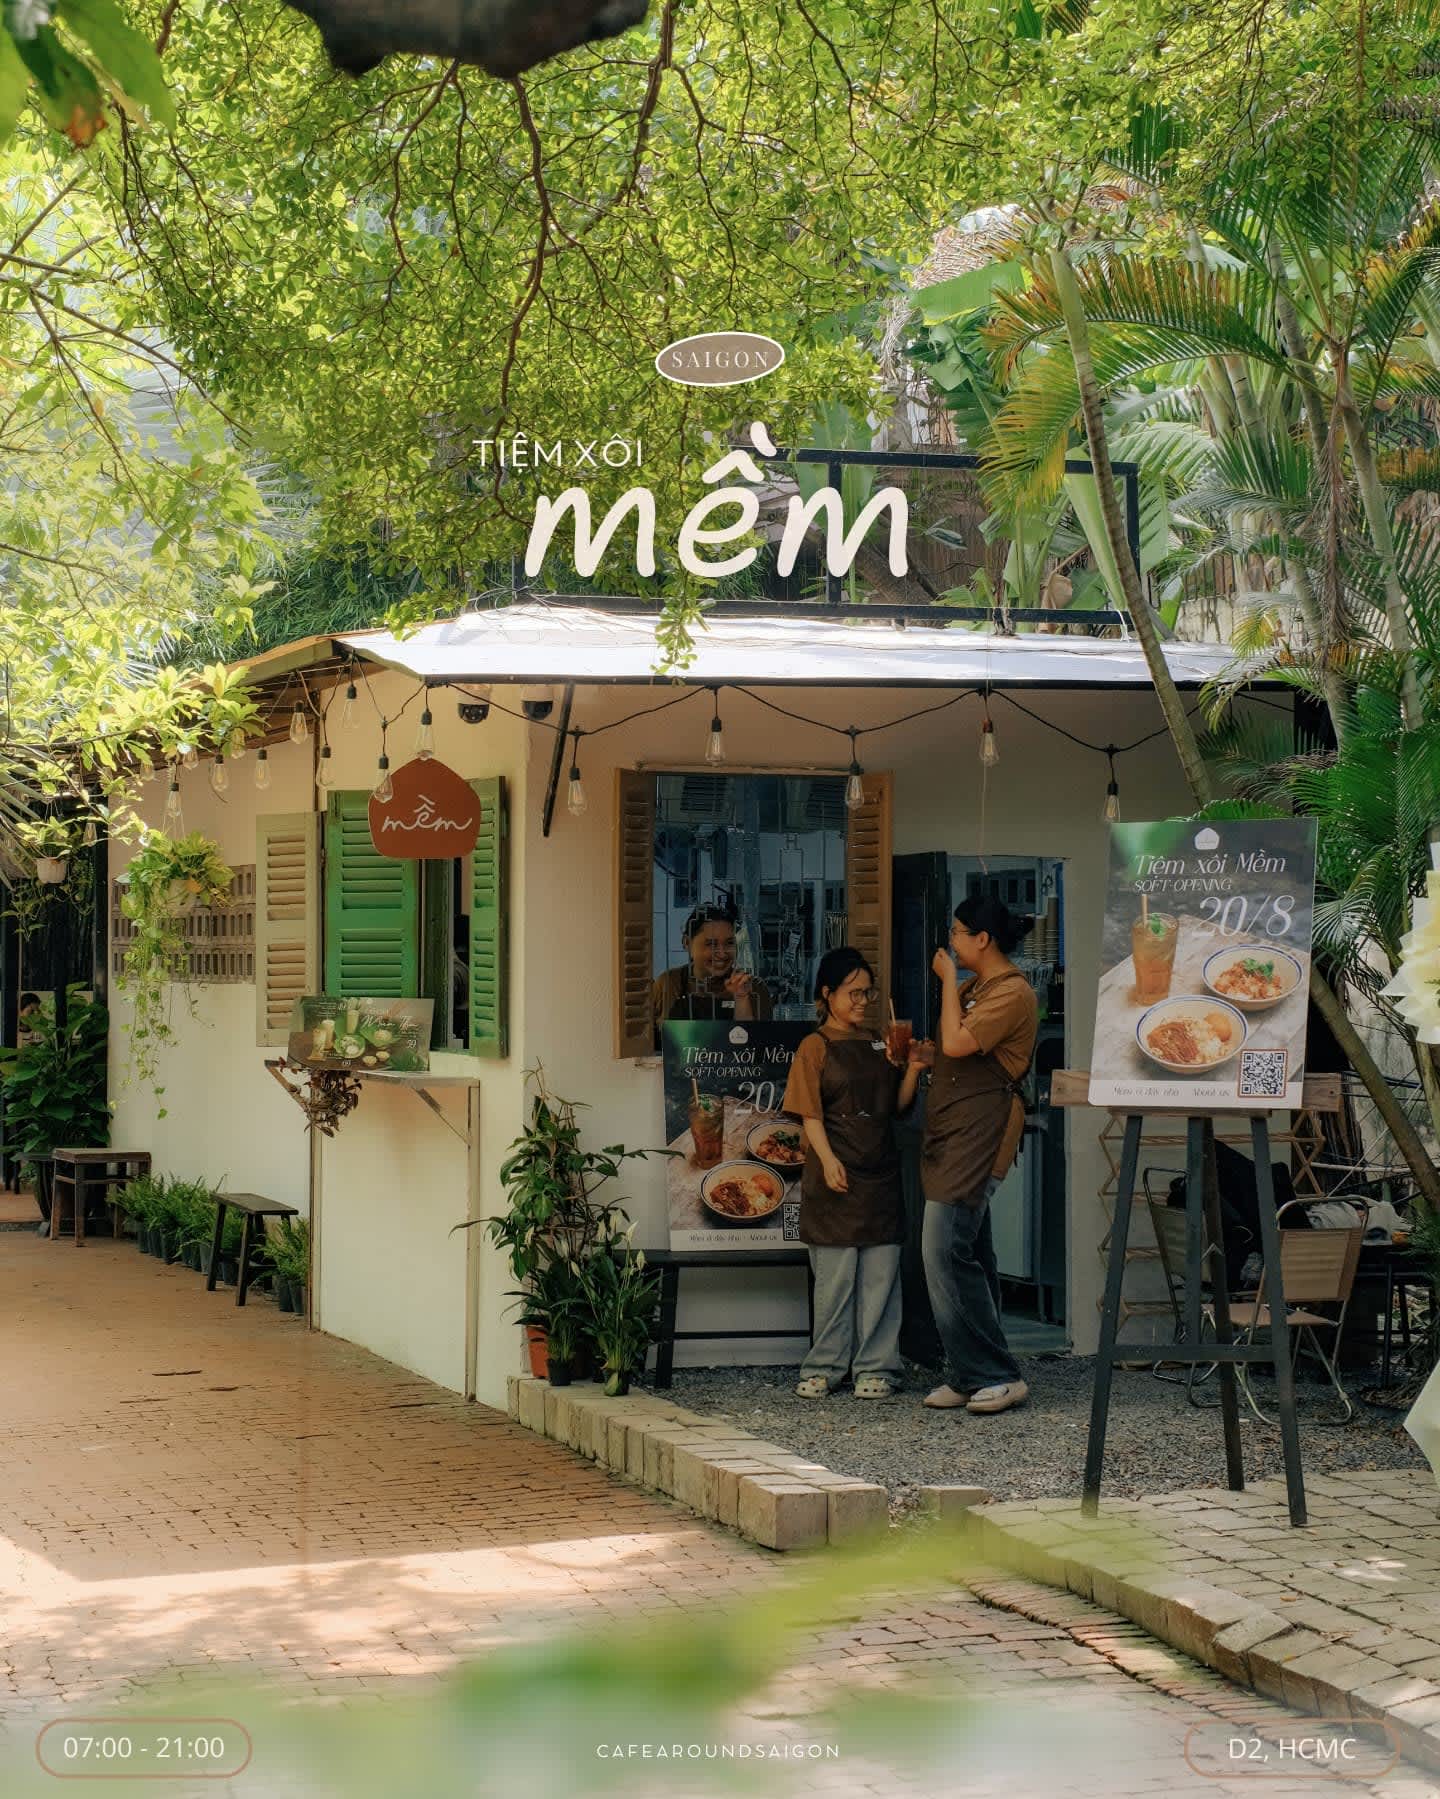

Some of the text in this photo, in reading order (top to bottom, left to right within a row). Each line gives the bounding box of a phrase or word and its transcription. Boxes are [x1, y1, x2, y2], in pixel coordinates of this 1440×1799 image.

[381, 794, 473, 833] mềm
[1134, 849, 1287, 879] Tiệm xôi Mềm
[1192, 895, 1296, 937] 20/8
[682, 1046, 724, 1066] Tiệm
[731, 1047, 756, 1064] xôi
